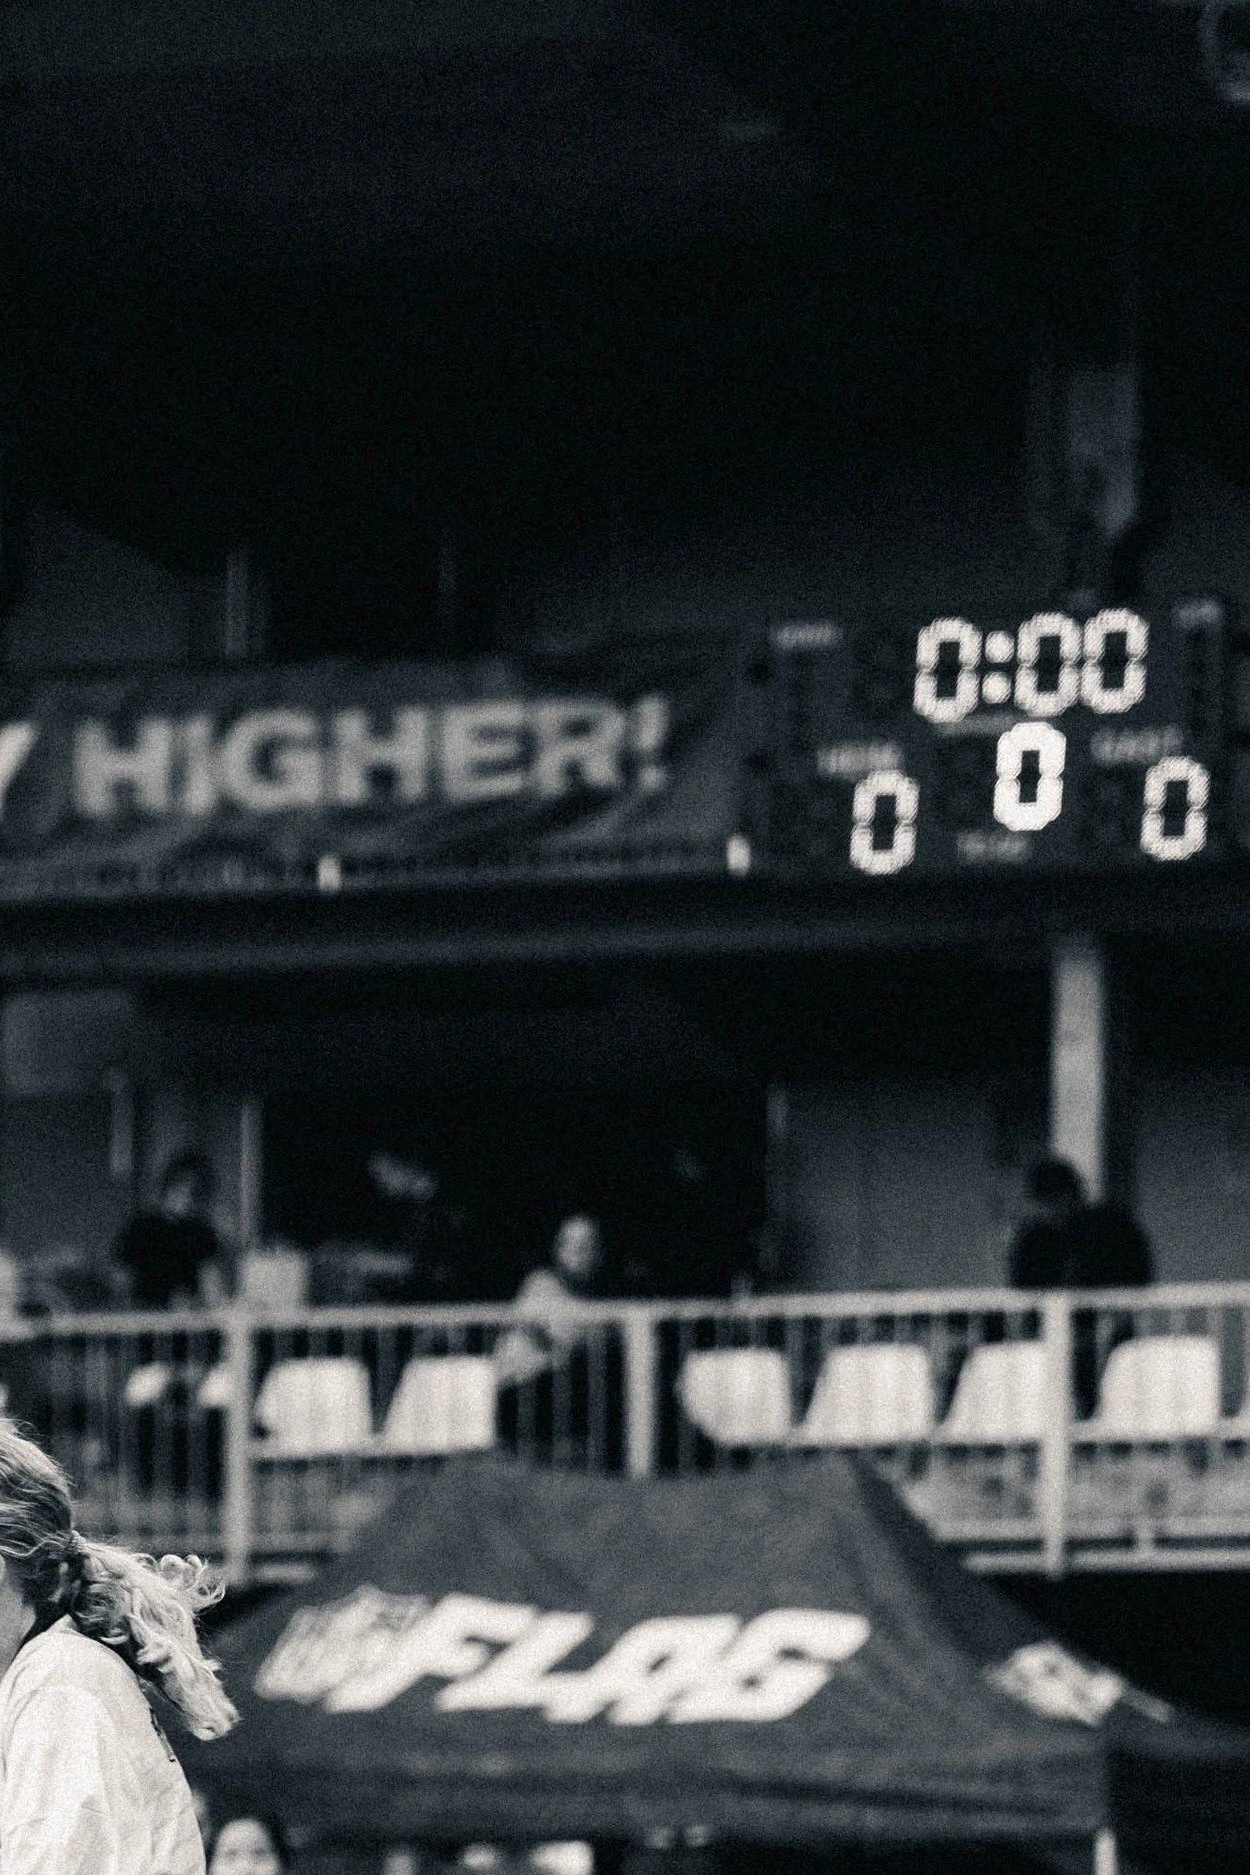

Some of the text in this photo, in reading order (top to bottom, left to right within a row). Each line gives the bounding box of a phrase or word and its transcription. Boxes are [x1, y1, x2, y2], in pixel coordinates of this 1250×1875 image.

[913, 608, 1149, 724] 0:00
[71, 696, 669, 817] HIGHER!
[993, 721, 1067, 832] 0
[1141, 755, 1211, 861] 0
[850, 770, 920, 875] 0
[325, 1595, 872, 1726] FLAG
